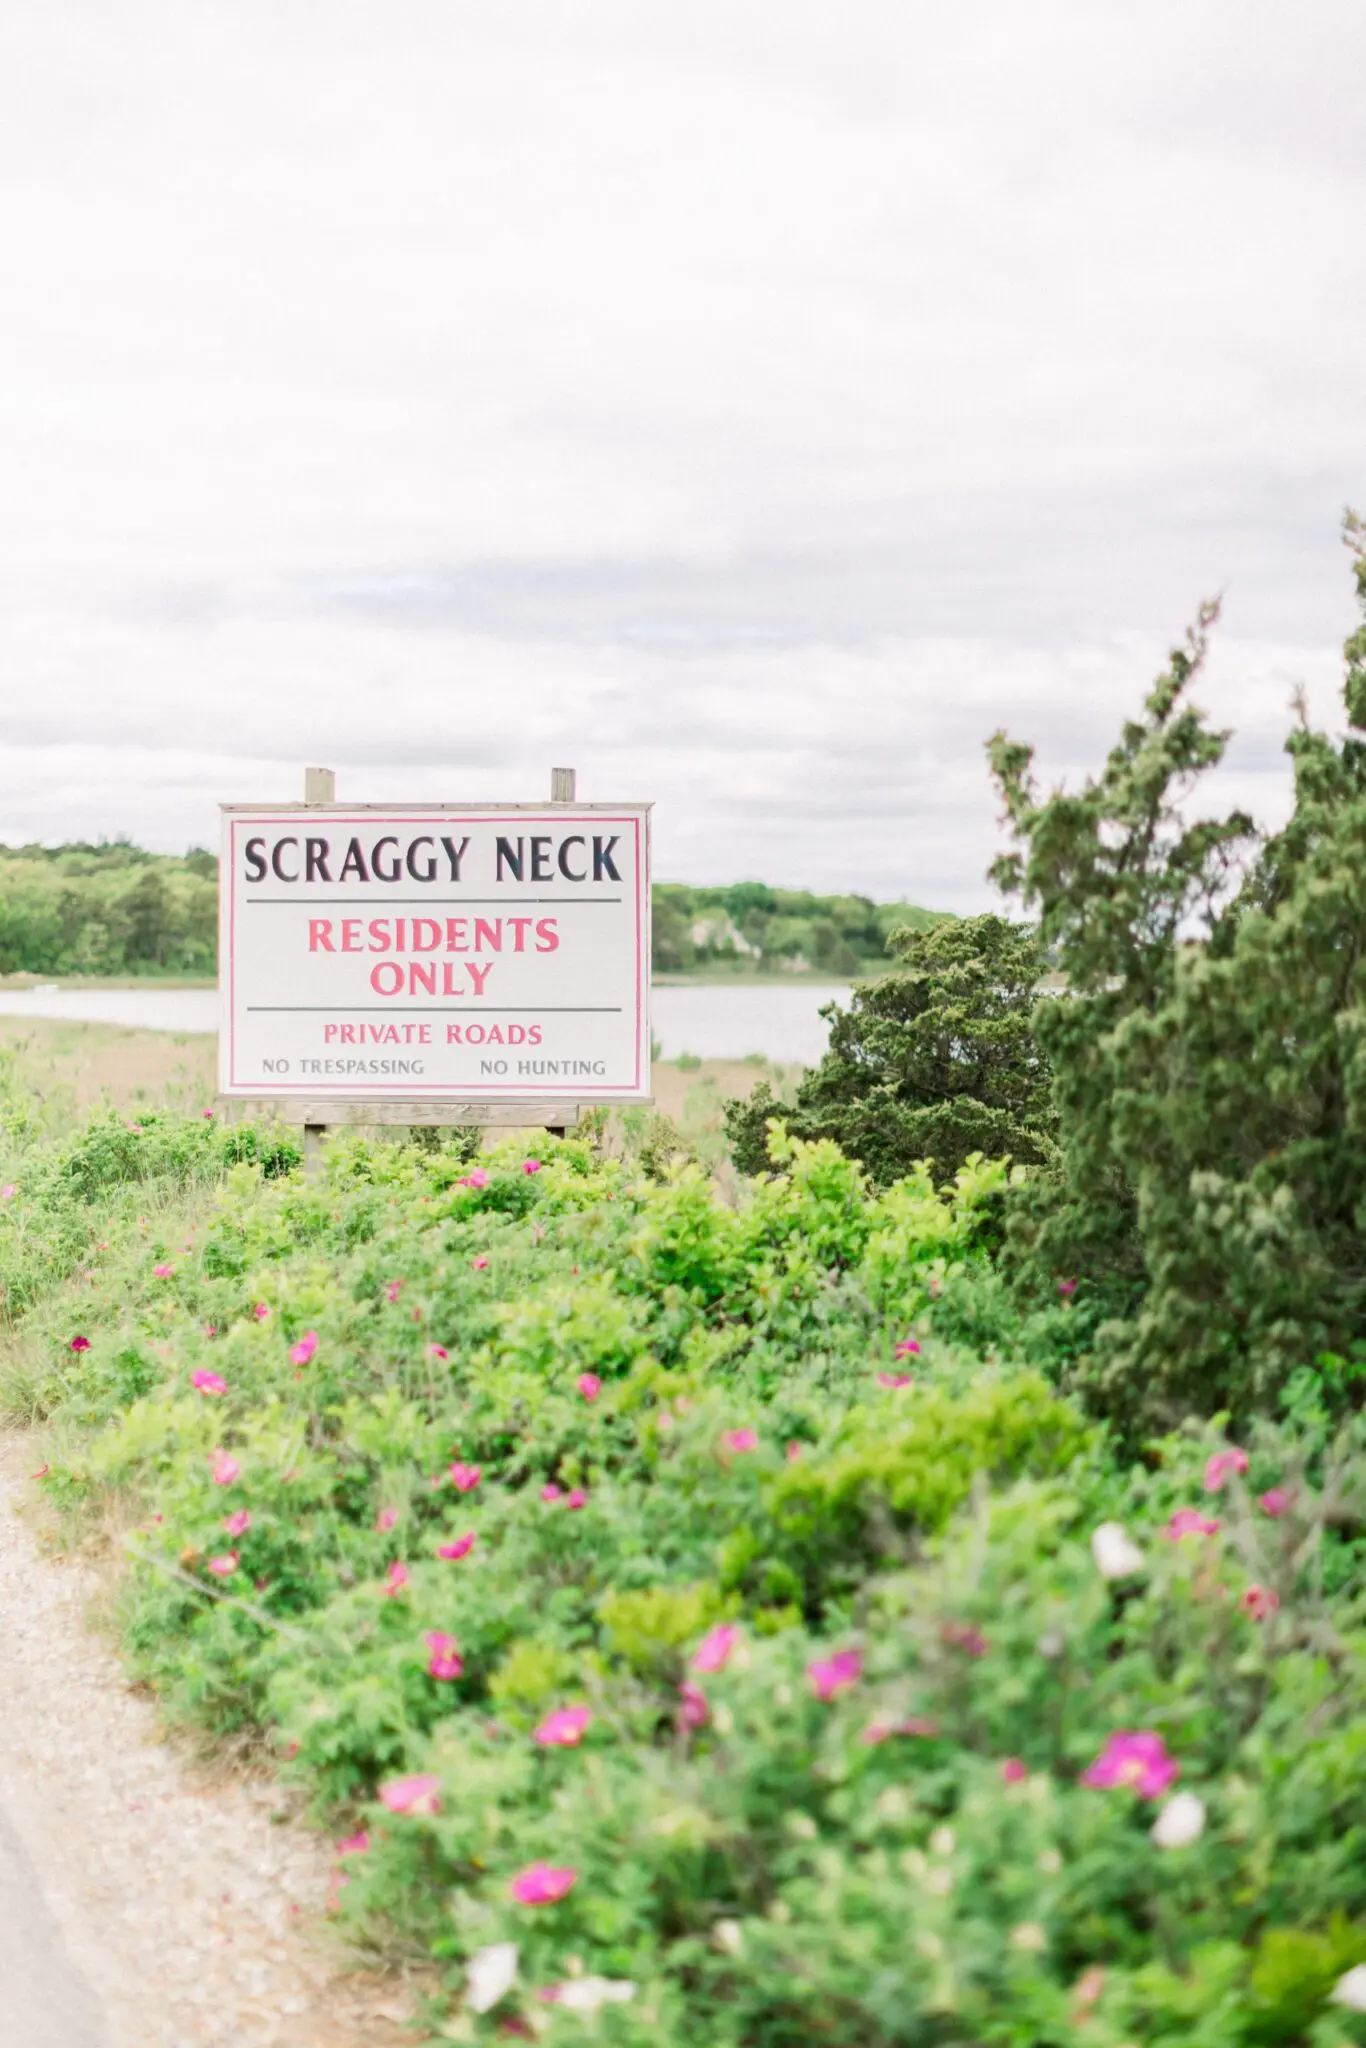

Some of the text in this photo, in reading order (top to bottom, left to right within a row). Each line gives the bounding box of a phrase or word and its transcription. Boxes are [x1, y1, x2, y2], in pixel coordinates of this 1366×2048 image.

[244, 835, 623, 883] SCRAGGY NECK
[308, 917, 559, 953] RESIDENTS
[369, 961, 493, 996] ONLY
[323, 1024, 543, 1045] PRIVATE ROADS
[262, 1059, 424, 1075] NO TRESPASSING
[480, 1060, 605, 1076] NO HUNTING
